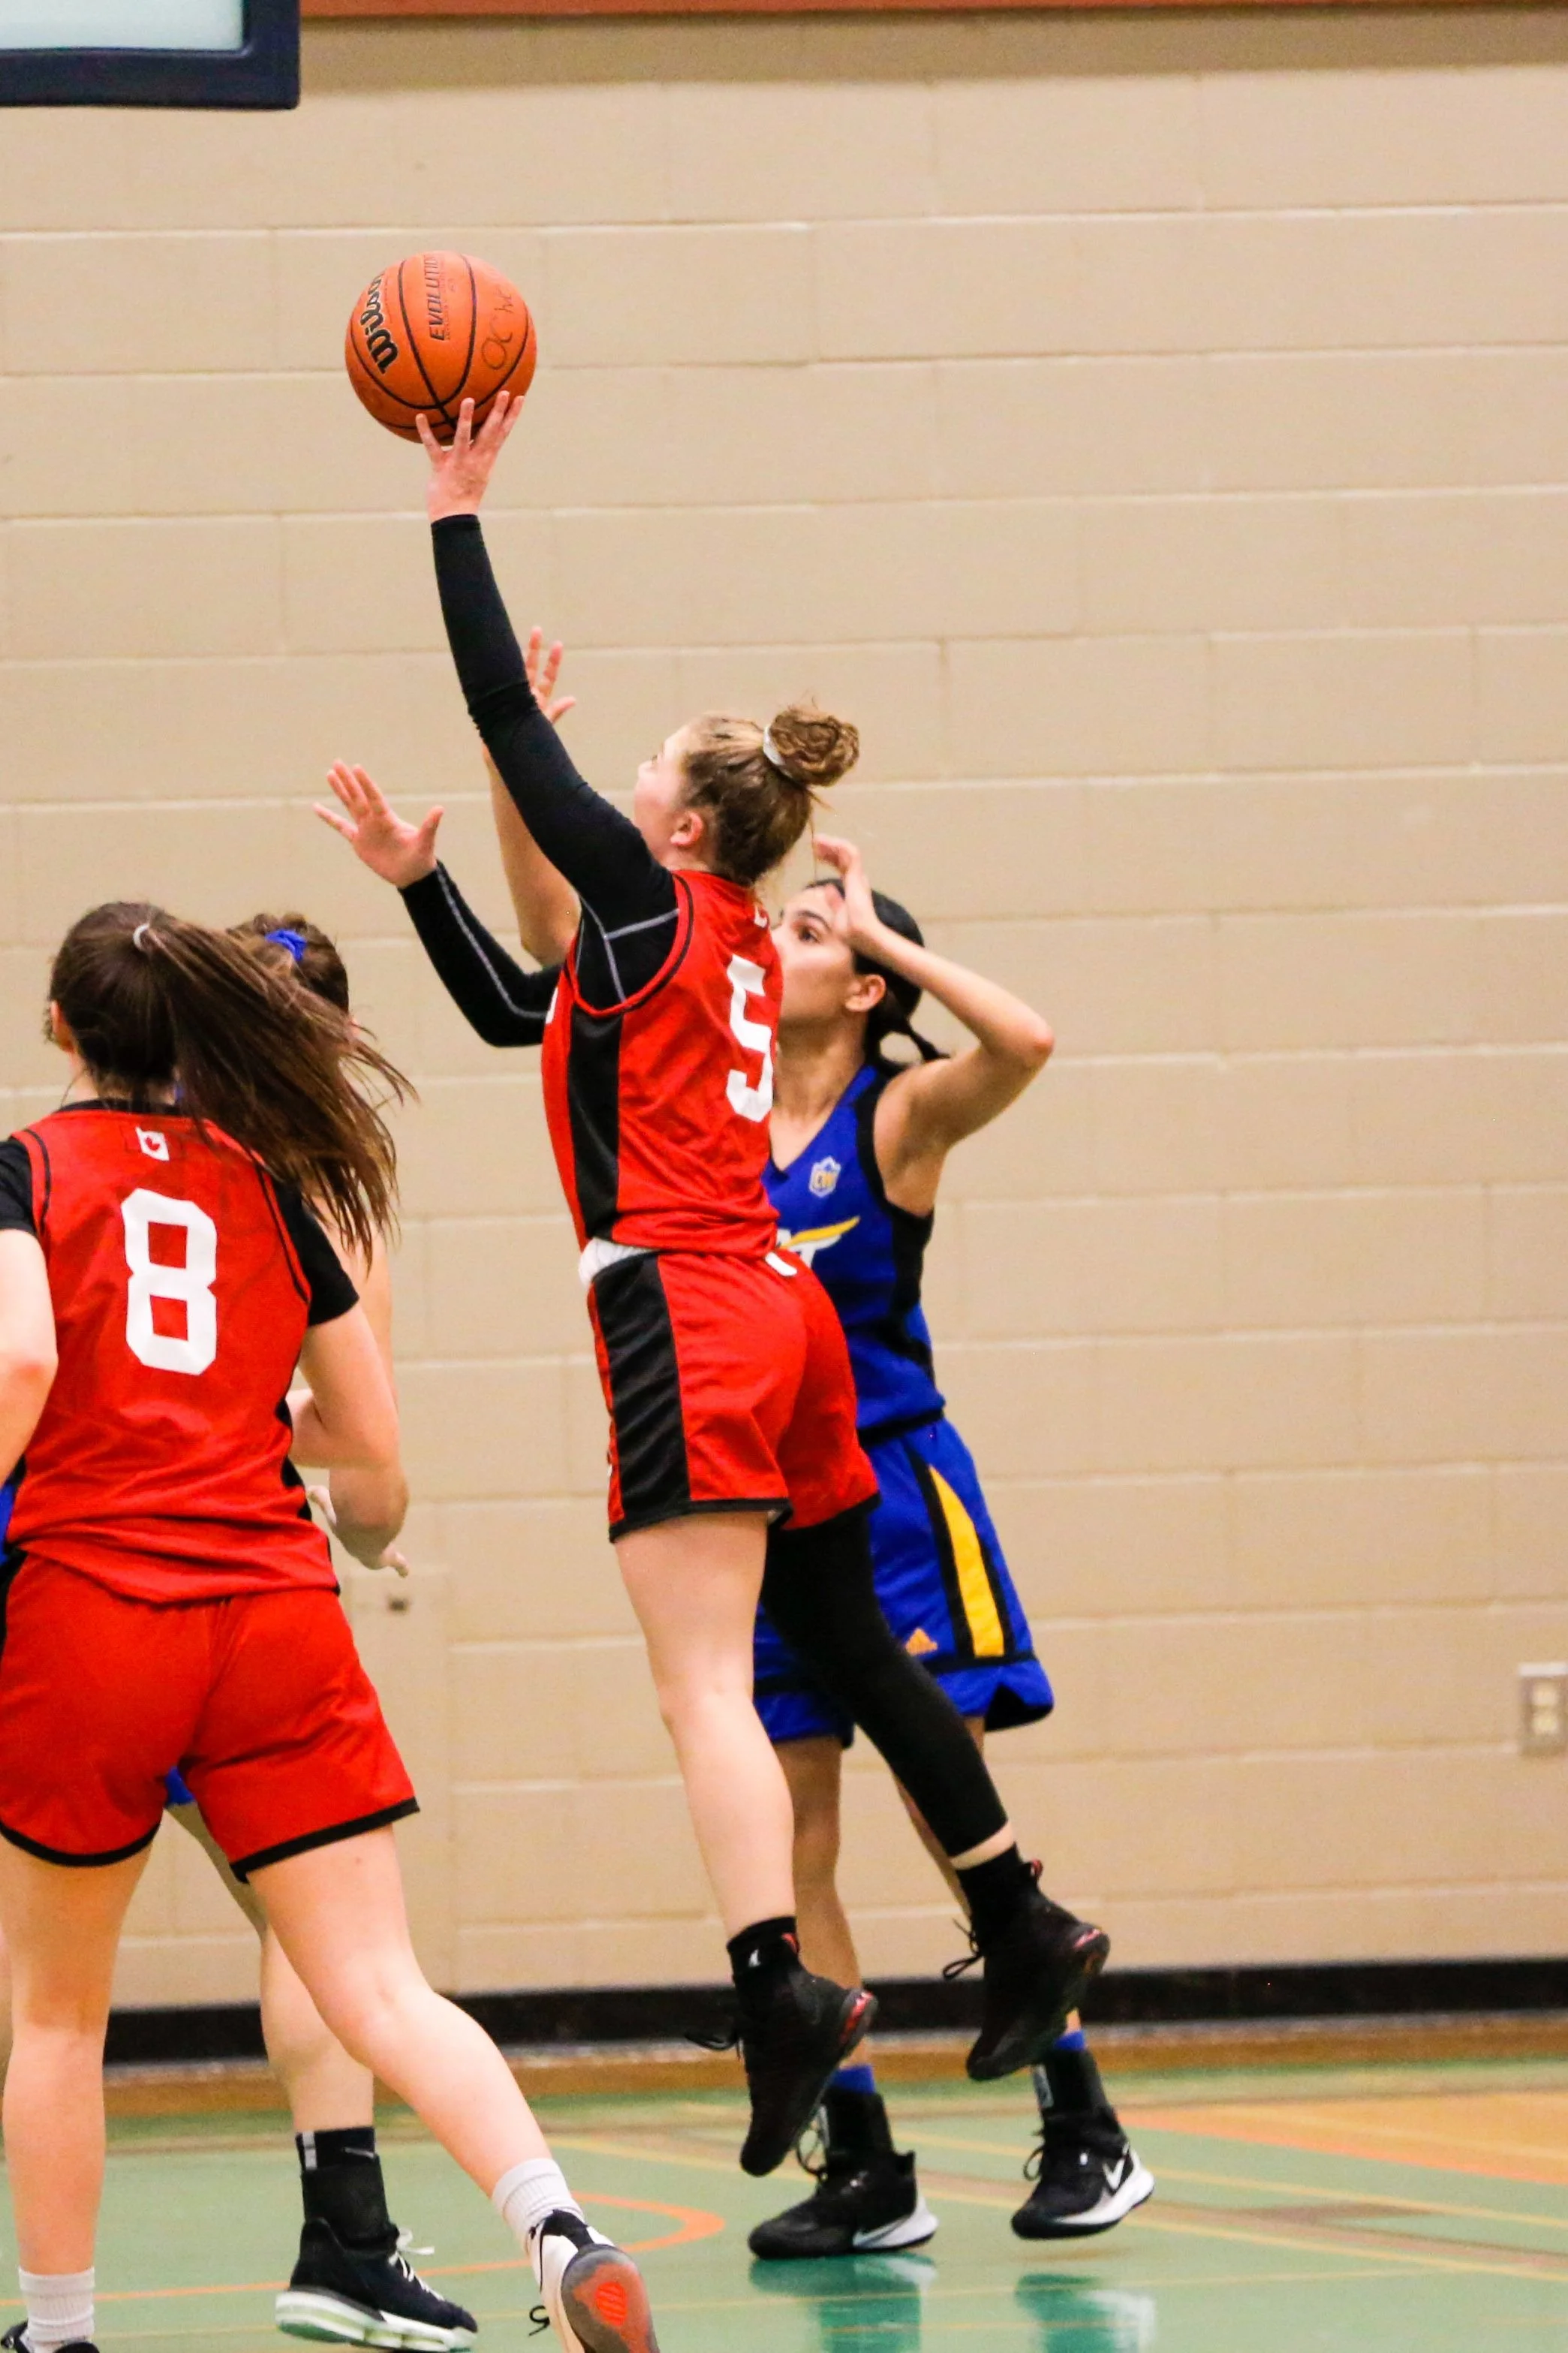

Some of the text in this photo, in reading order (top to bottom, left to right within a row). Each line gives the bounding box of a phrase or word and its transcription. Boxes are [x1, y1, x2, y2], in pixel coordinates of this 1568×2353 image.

[423, 256, 444, 340] EVOLUTIO
[726, 954, 773, 1122] 5
[121, 1188, 217, 1375] 8
